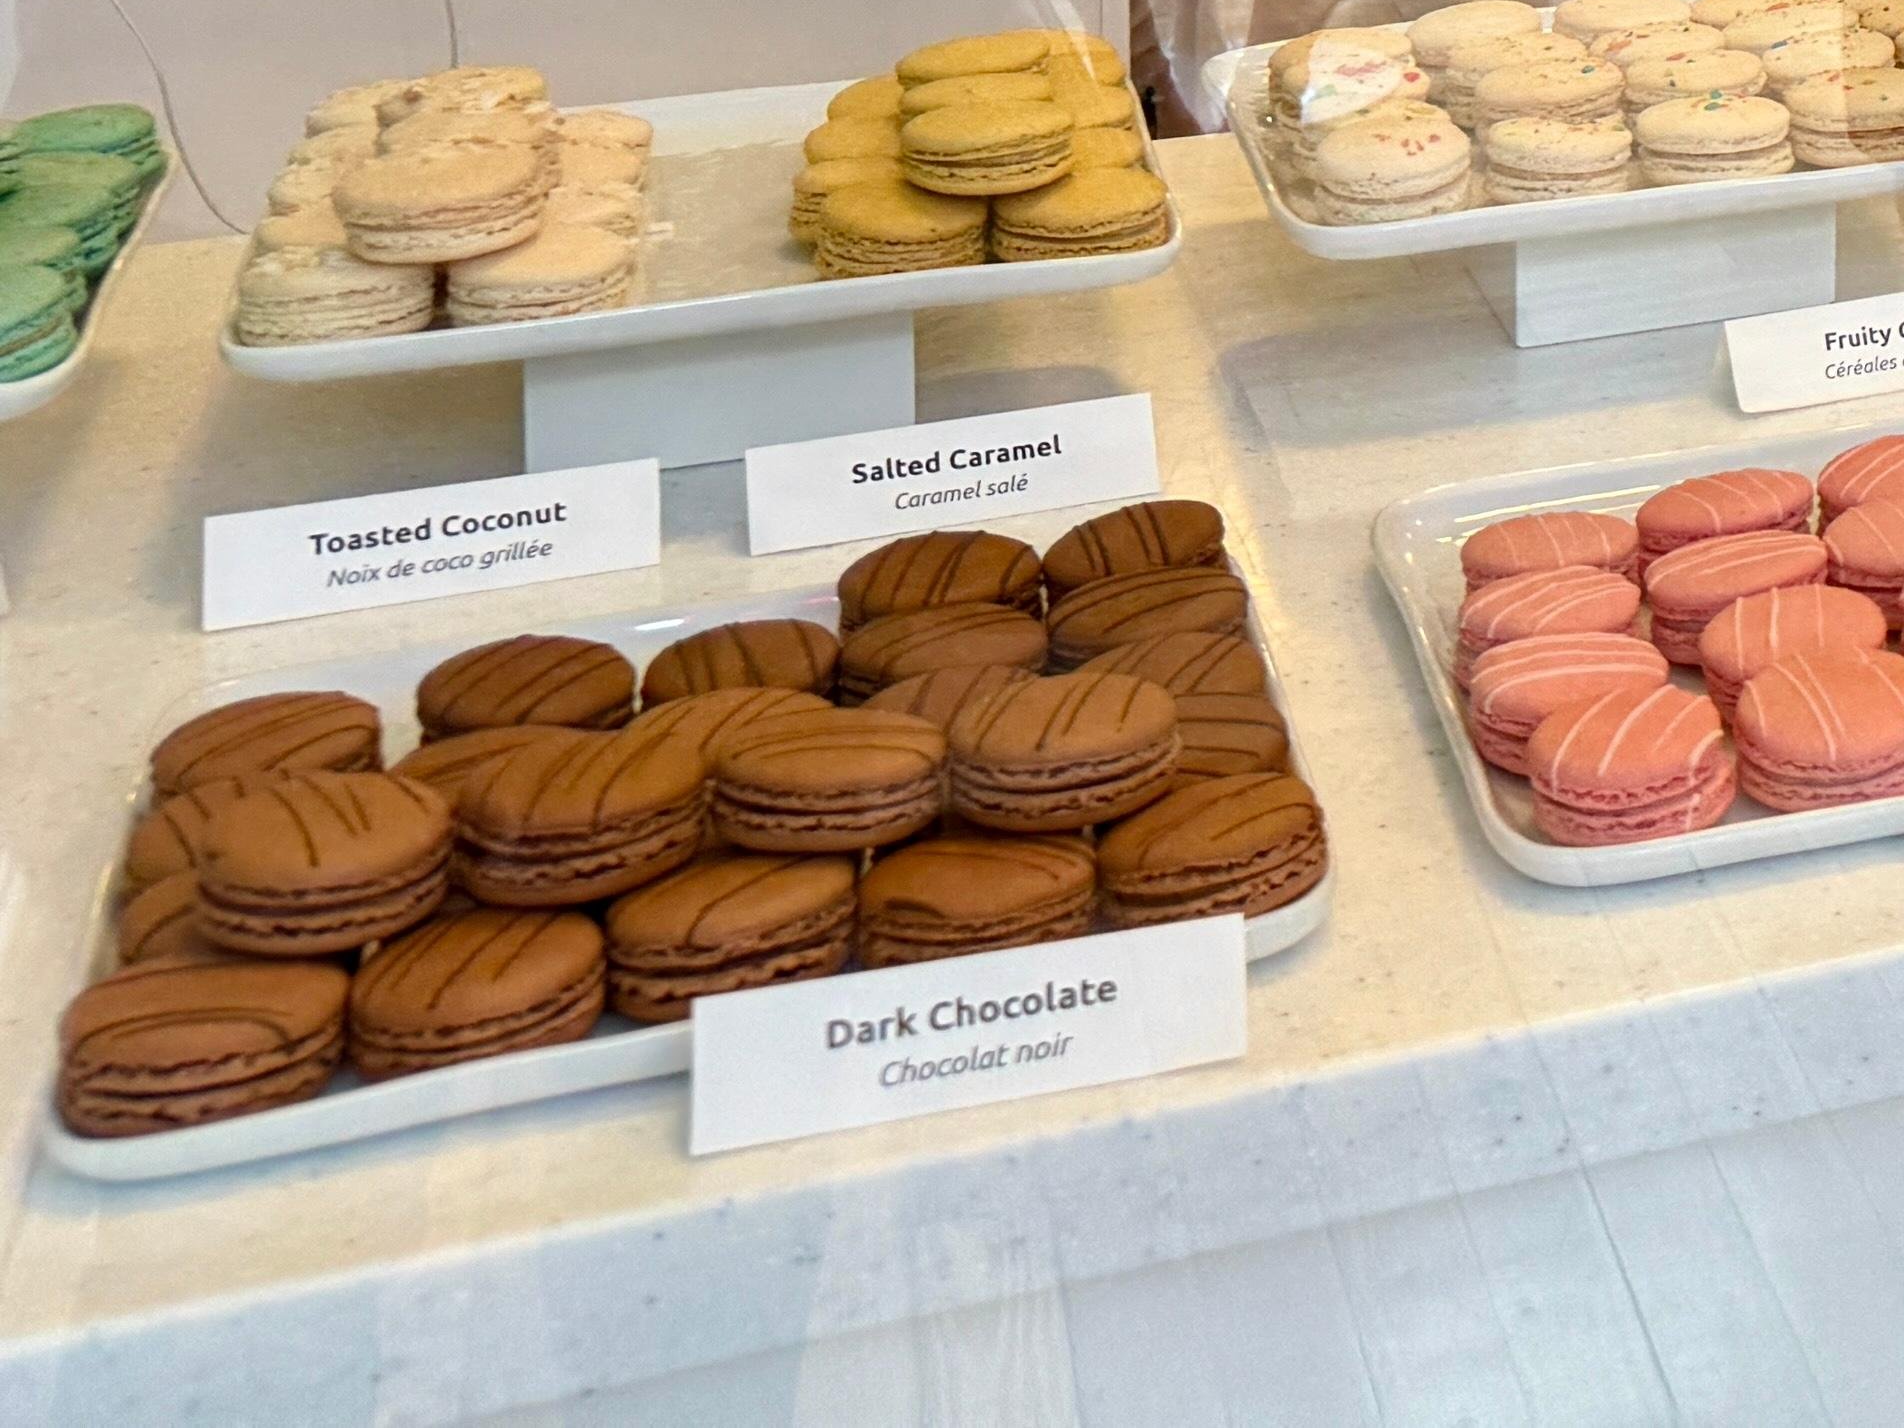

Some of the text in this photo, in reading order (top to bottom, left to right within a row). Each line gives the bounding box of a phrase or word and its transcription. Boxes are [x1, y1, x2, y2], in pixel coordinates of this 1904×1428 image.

[1824, 325, 1891, 351] Fruity
[1825, 355, 1897, 379] Céréales
[851, 434, 1062, 485] Salted Caramel
[894, 472, 1029, 510] Caramel salé
[308, 501, 567, 556] Toasted Coconut
[326, 539, 553, 588] Noix de coco grillée
[825, 976, 1118, 1050] Dark Chocolate
[878, 1032, 1074, 1088] Chocolat noir
